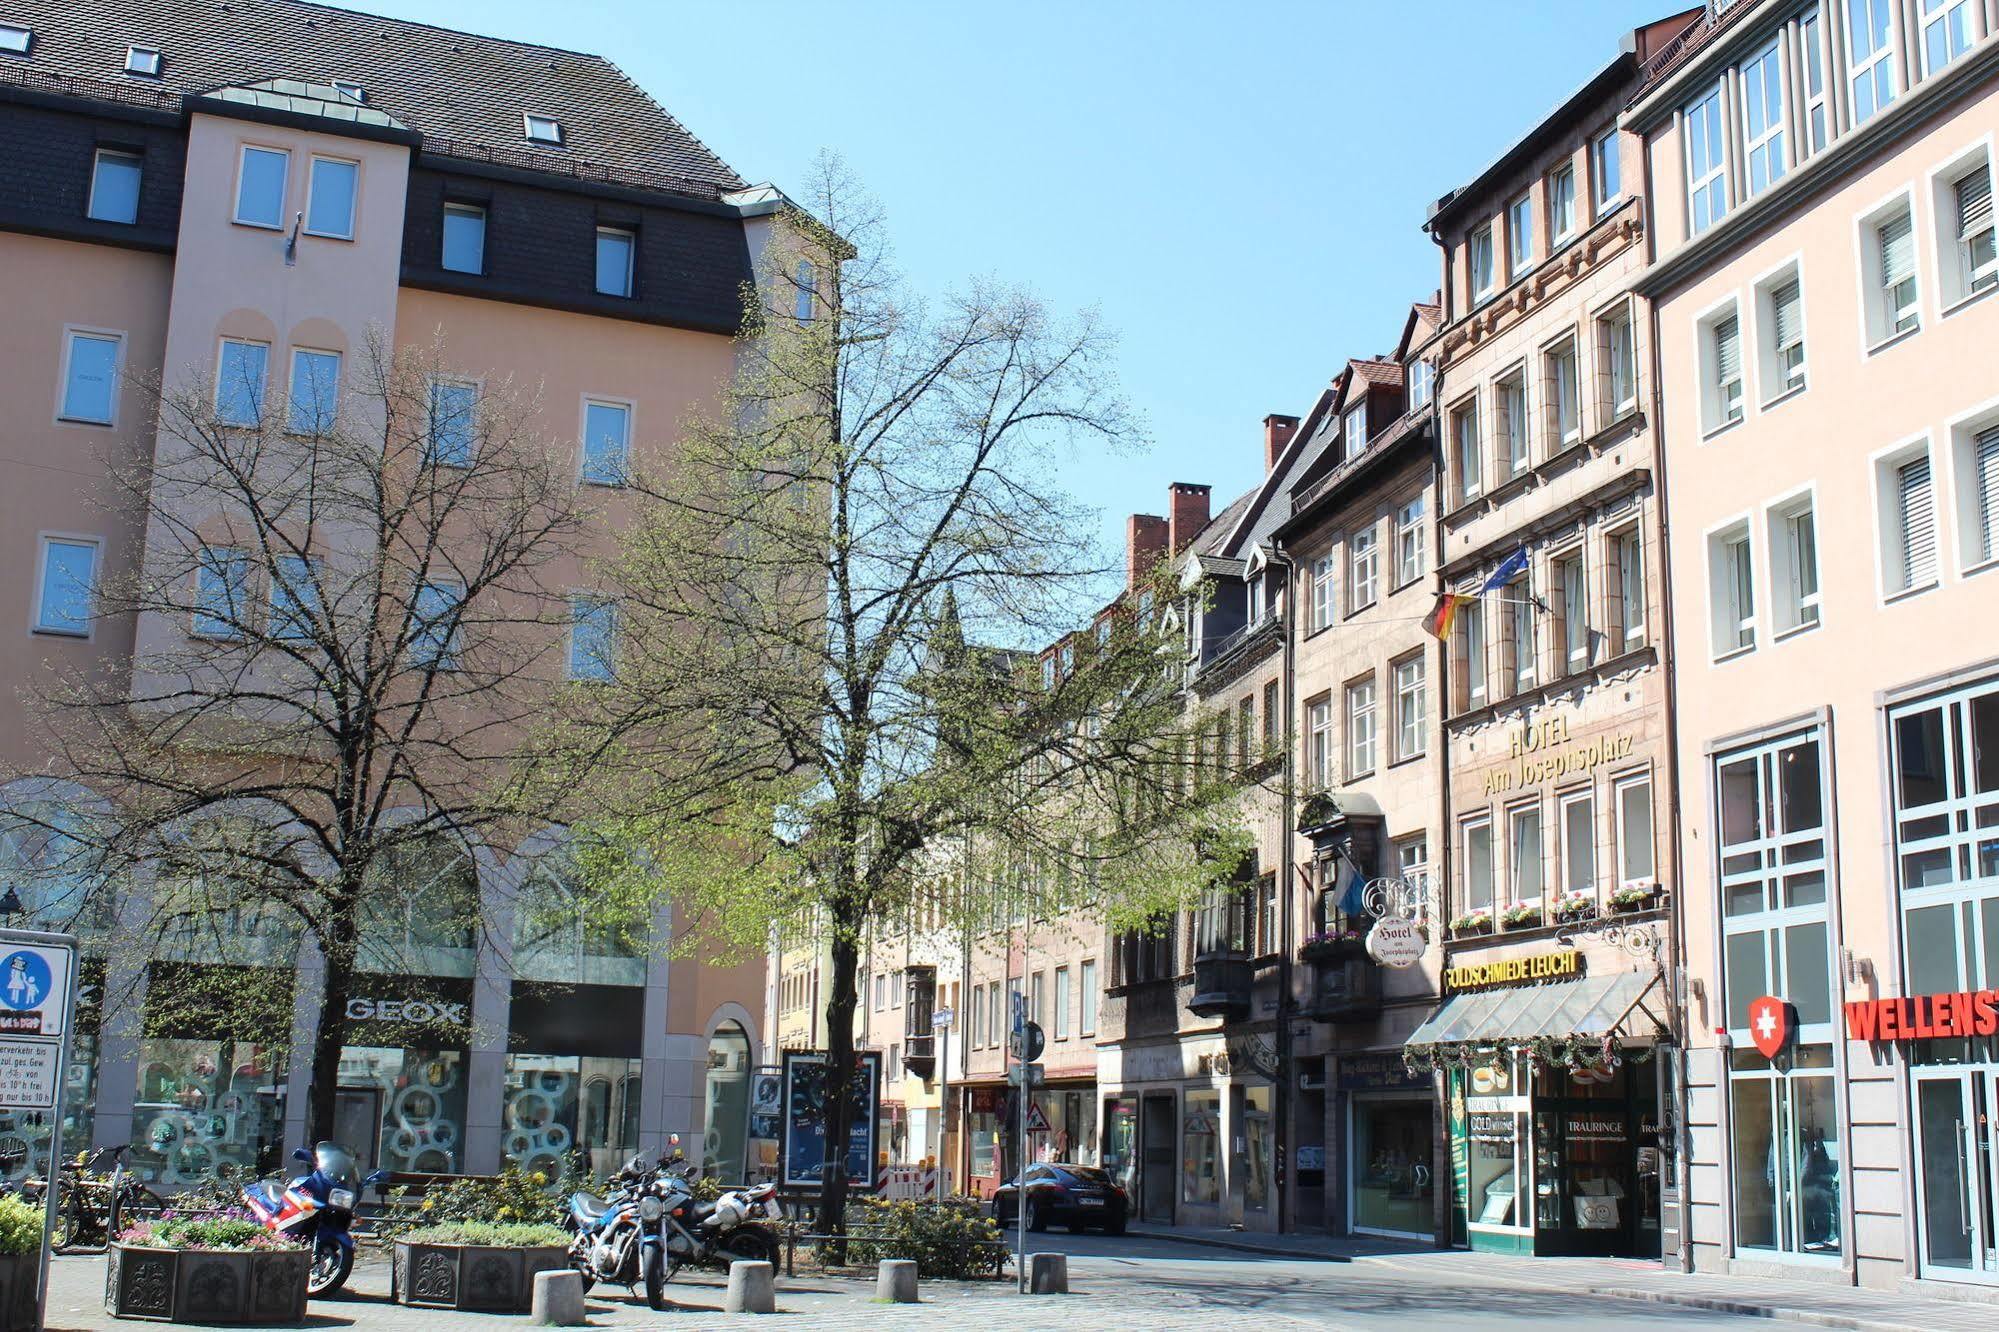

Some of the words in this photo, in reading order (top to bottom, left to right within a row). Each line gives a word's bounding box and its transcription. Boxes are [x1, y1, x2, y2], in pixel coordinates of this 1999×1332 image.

[1509, 714, 1571, 758] HOTEL
[1484, 766, 1511, 796] Am
[1518, 731, 1634, 790] Josephsplatz
[1380, 927, 1411, 940] Hotel
[1444, 959, 1528, 988] GOLDSCHMIEDE
[1530, 951, 1576, 977] LEUCHT
[345, 998, 466, 1024] GEOX
[1845, 989, 1999, 1041] WELLENS
[1568, 1121, 1623, 1133] TRAURINGE
